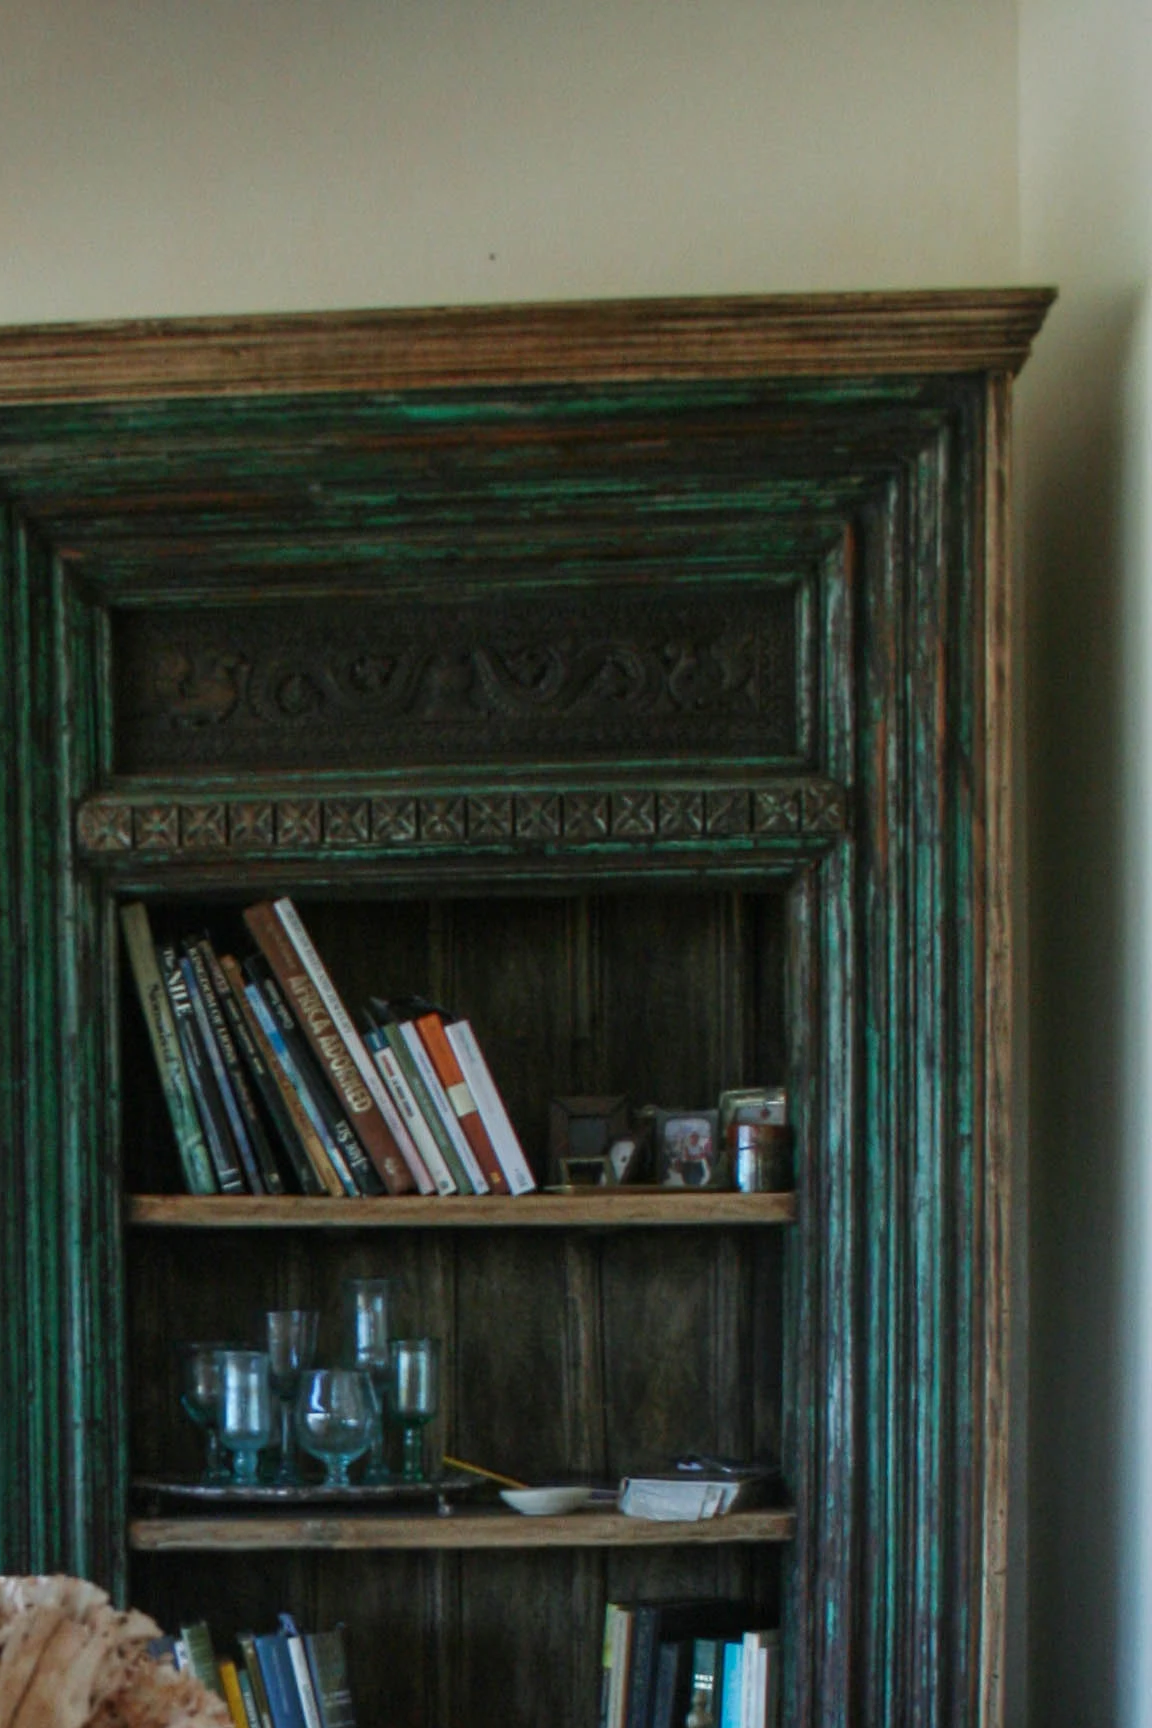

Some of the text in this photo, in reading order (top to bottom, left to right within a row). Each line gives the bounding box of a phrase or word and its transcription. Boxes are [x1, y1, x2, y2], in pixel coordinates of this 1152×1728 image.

[167, 969, 193, 1018] NILE
[288, 976, 334, 1036] AFRICA
[318, 1035, 373, 1114] ADORNED
